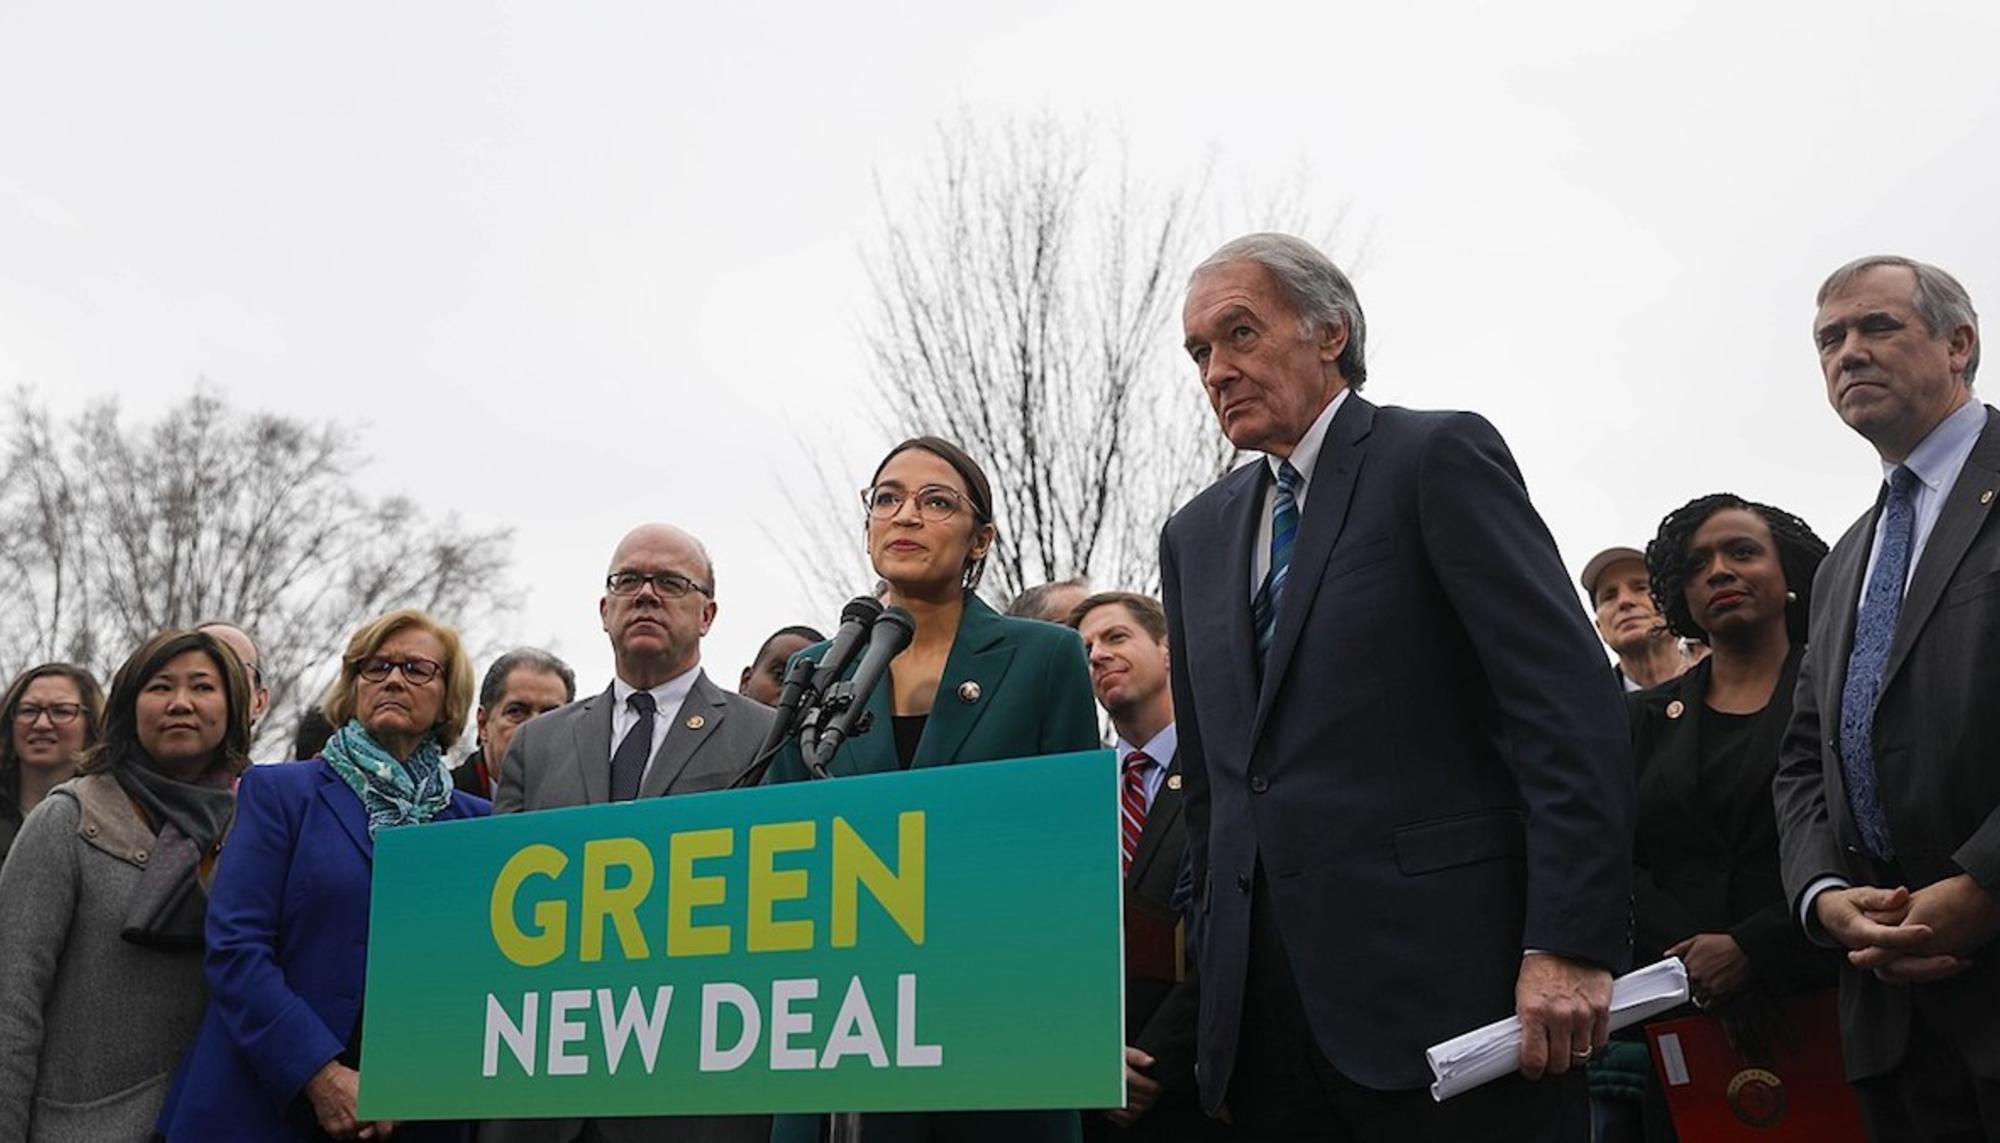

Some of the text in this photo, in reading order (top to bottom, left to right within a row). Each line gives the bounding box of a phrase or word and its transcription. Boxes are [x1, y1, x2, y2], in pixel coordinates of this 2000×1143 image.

[490, 810, 925, 967] GREEN
[482, 973, 943, 1077] NEW DEAL
